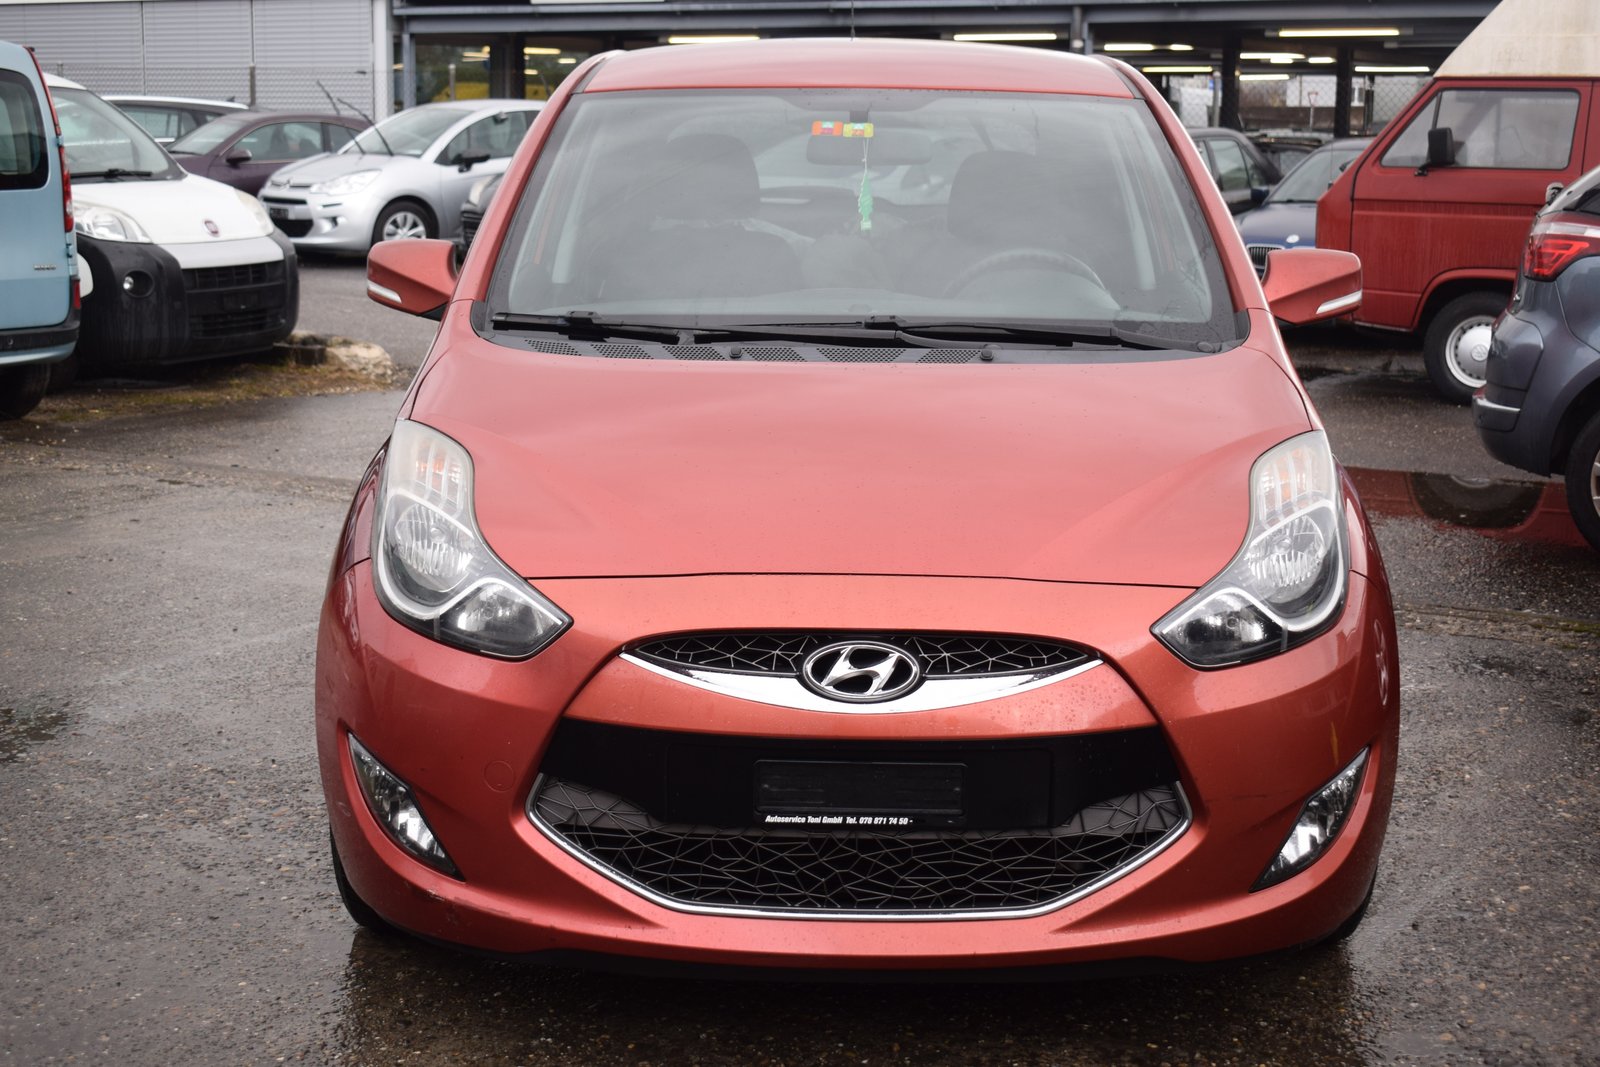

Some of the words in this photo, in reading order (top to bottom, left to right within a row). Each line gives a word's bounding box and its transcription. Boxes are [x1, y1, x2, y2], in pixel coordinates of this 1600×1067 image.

[765, 815, 806, 823] Autoservice
[807, 815, 822, 824] Toni
[822, 816, 843, 824] GmbH
[846, 816, 858, 824] Tel.
[889, 817, 898, 825] 74
[899, 817, 909, 825] 50
